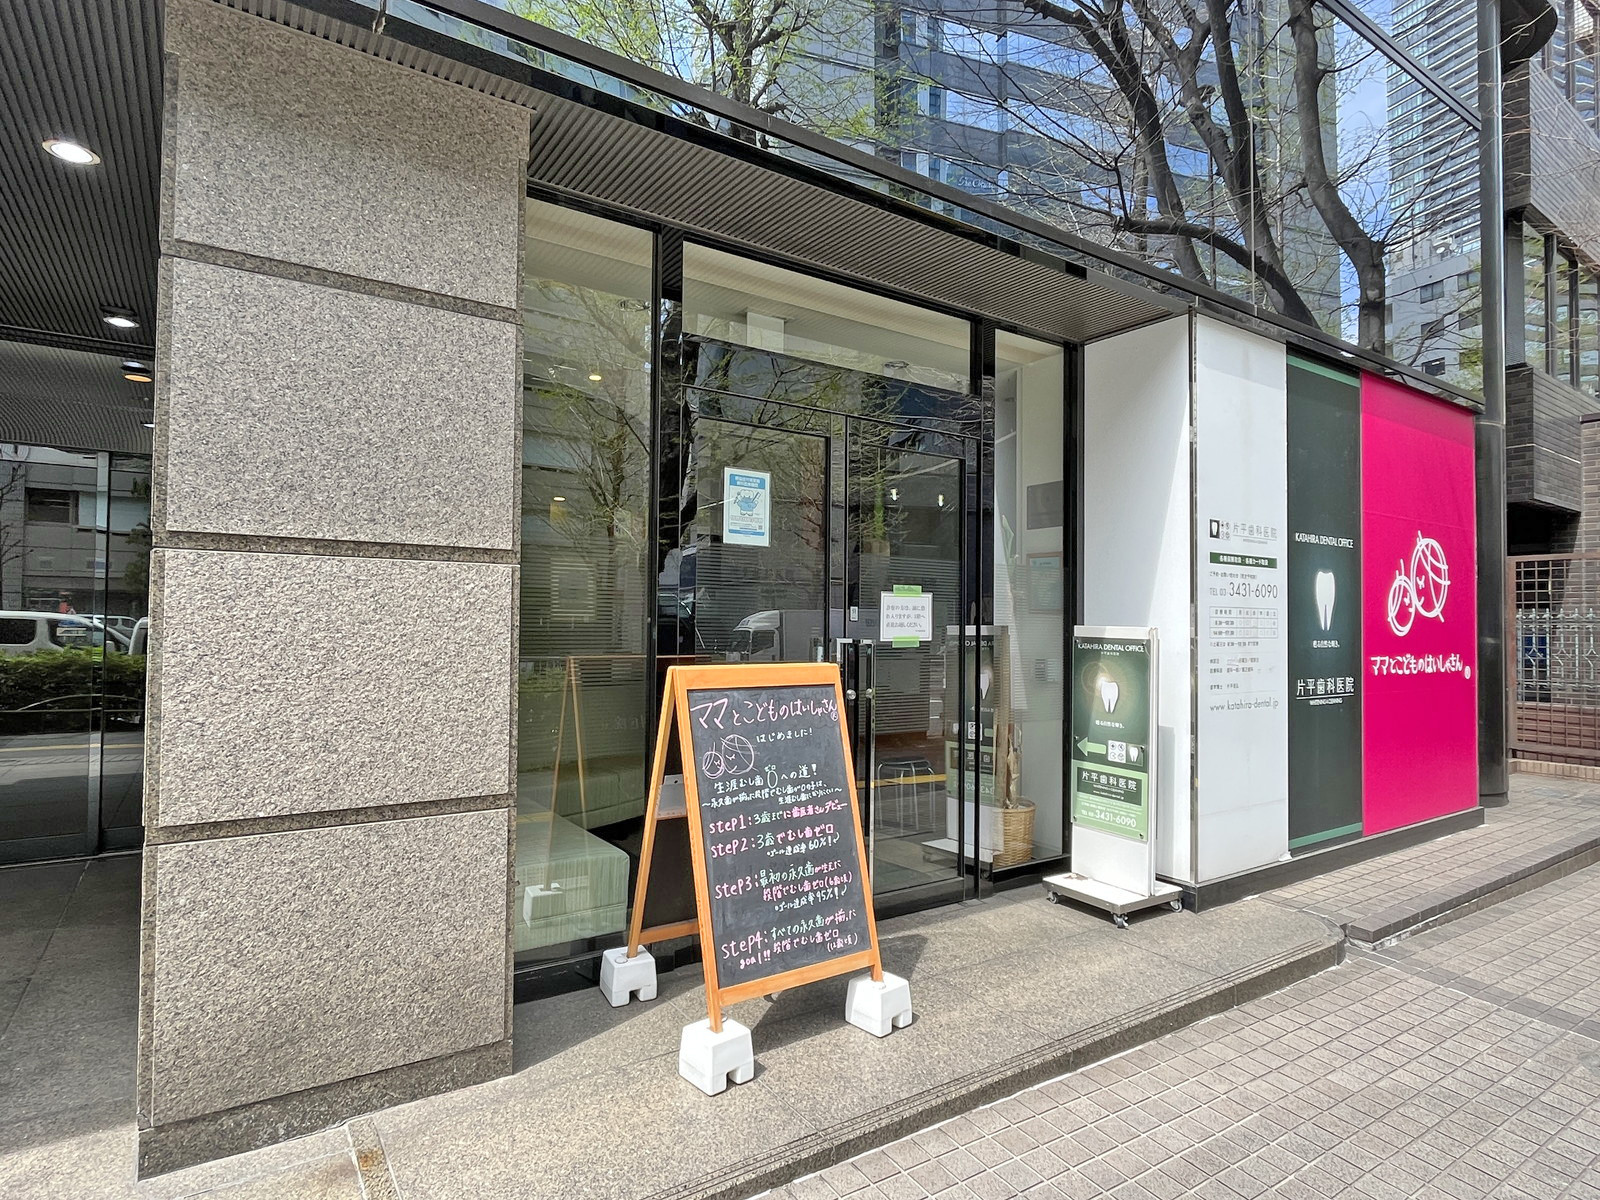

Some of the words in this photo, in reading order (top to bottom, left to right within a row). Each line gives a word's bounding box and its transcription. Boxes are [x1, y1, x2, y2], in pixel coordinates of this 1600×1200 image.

[1232, 522, 1278, 539] 片平歯科医院
[1295, 532, 1320, 544] KATAHIRA
[1320, 535, 1338, 547] DENTAL
[1338, 537, 1353, 549] OFFICE
[1077, 642, 1103, 650] KATAHIRA
[1103, 643, 1125, 652] DENTAL
[1125, 645, 1145, 653] OFFICE
[1370, 653, 1463, 676] ママとこどものはいしゃさん
[1296, 676, 1355, 696] 片平歯科医院
[690, 698, 838, 729] ママとこどものはいしゃさん
[1081, 770, 1137, 790] 片平歯科医院
